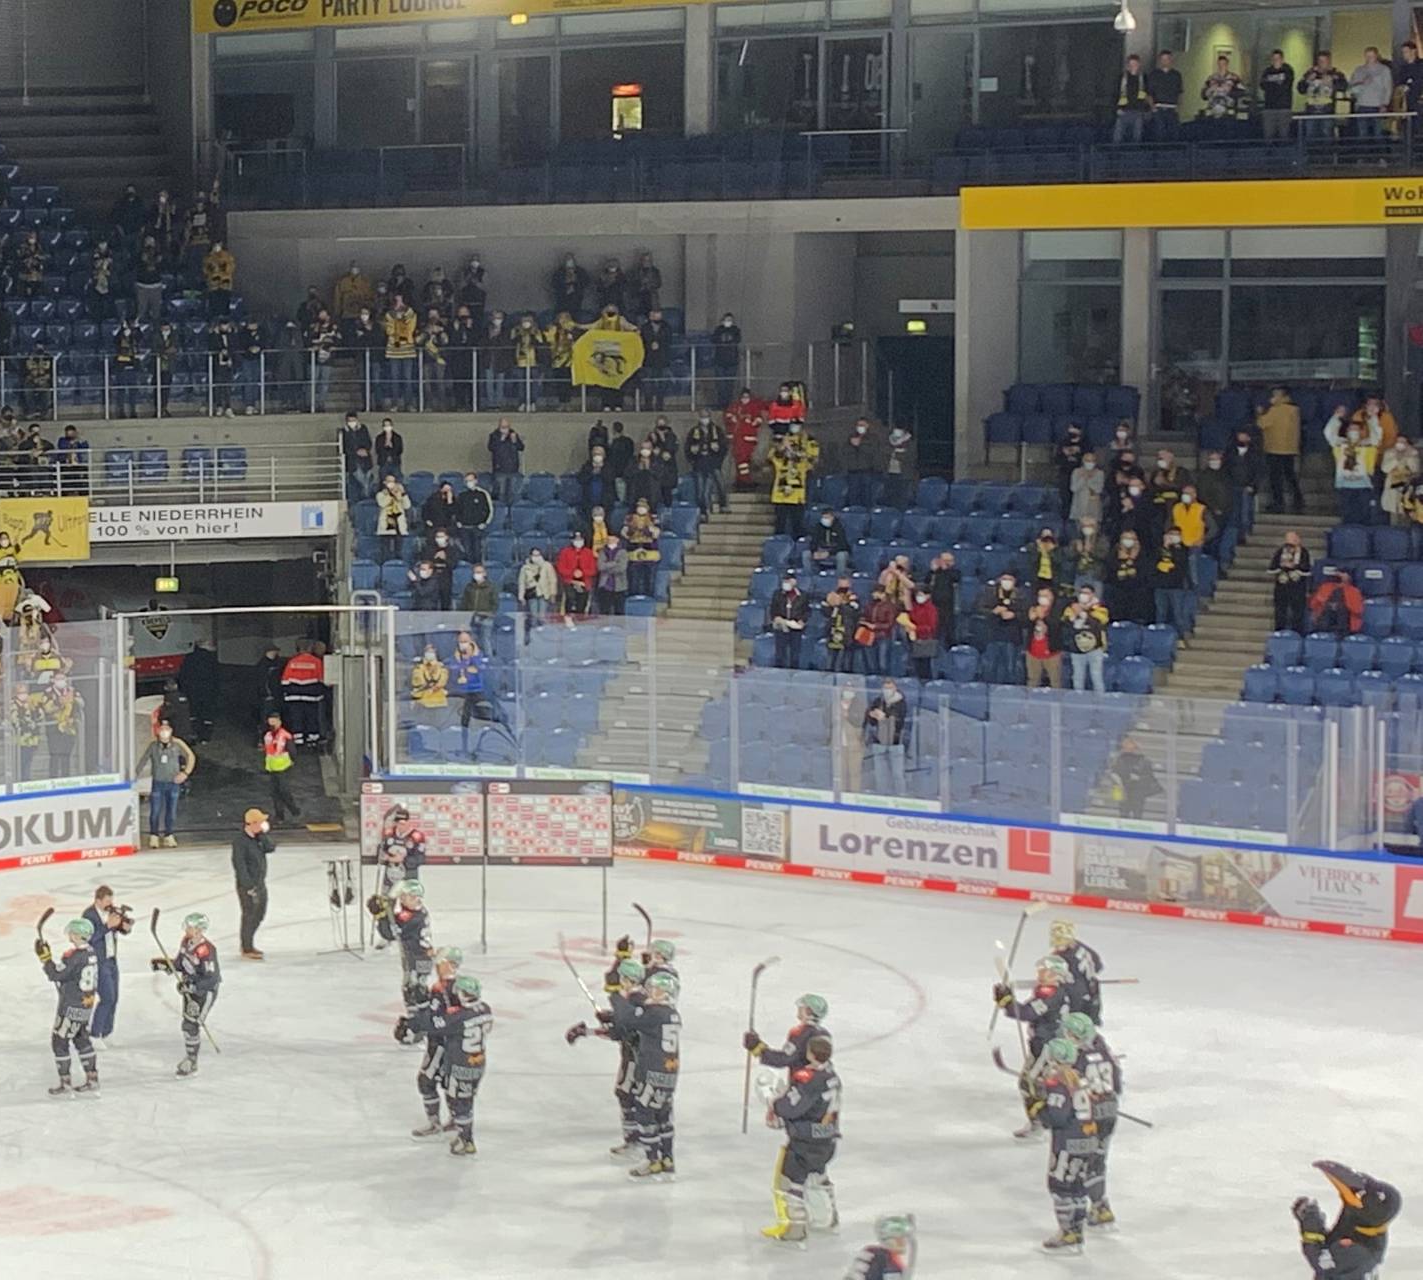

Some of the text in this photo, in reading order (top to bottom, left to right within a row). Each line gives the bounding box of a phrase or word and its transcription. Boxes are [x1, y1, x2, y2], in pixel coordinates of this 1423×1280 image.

[239, 0, 308, 17] POCO
[322, 0, 379, 17] PARTY
[139, 507, 264, 522] NIEDERRHEIN
[97, 526, 128, 537] 100
[135, 526, 151, 536] %
[156, 526, 189, 535] von
[886, 816, 998, 838] Gebäudetechnik
[819, 824, 998, 869] Lorenzen
[1298, 865, 1380, 885] VIEBROCK
